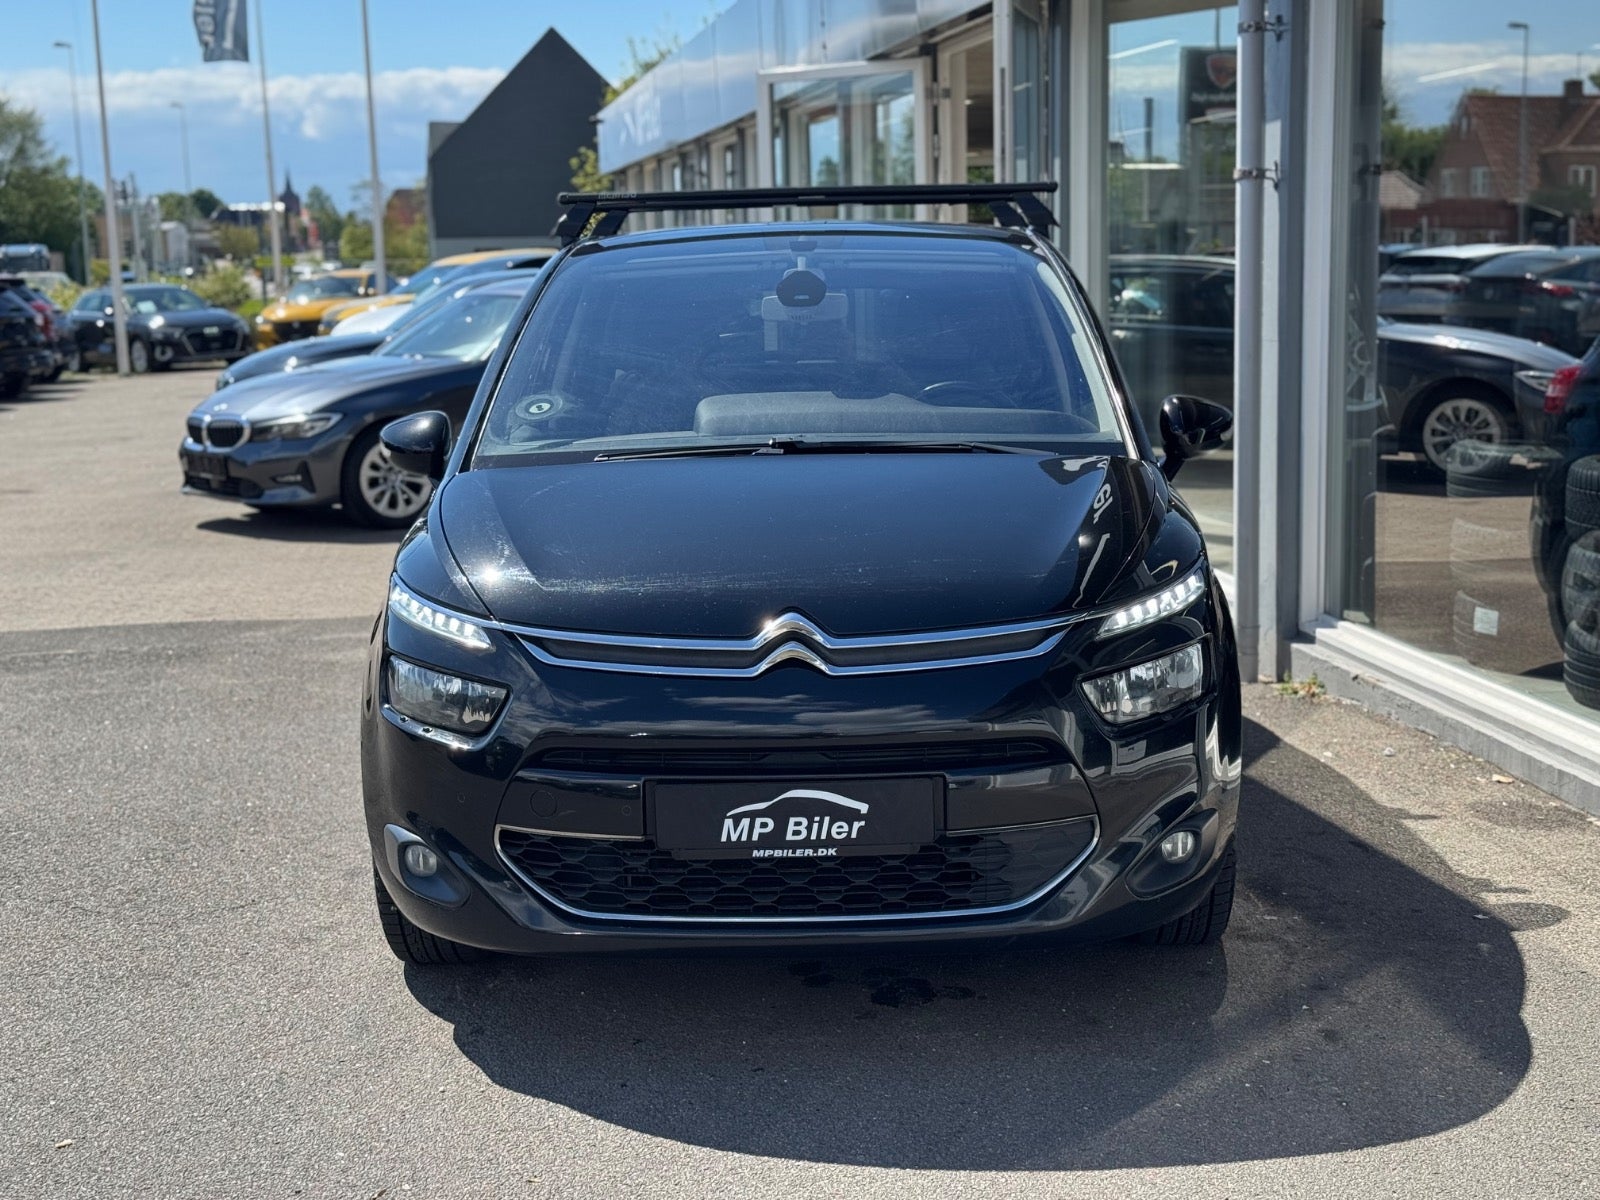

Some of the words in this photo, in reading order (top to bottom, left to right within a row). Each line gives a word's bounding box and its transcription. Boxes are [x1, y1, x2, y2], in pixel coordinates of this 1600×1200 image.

[720, 817, 775, 843] MP
[785, 816, 866, 841] Biler
[752, 847, 838, 858] MPBILER.DK
